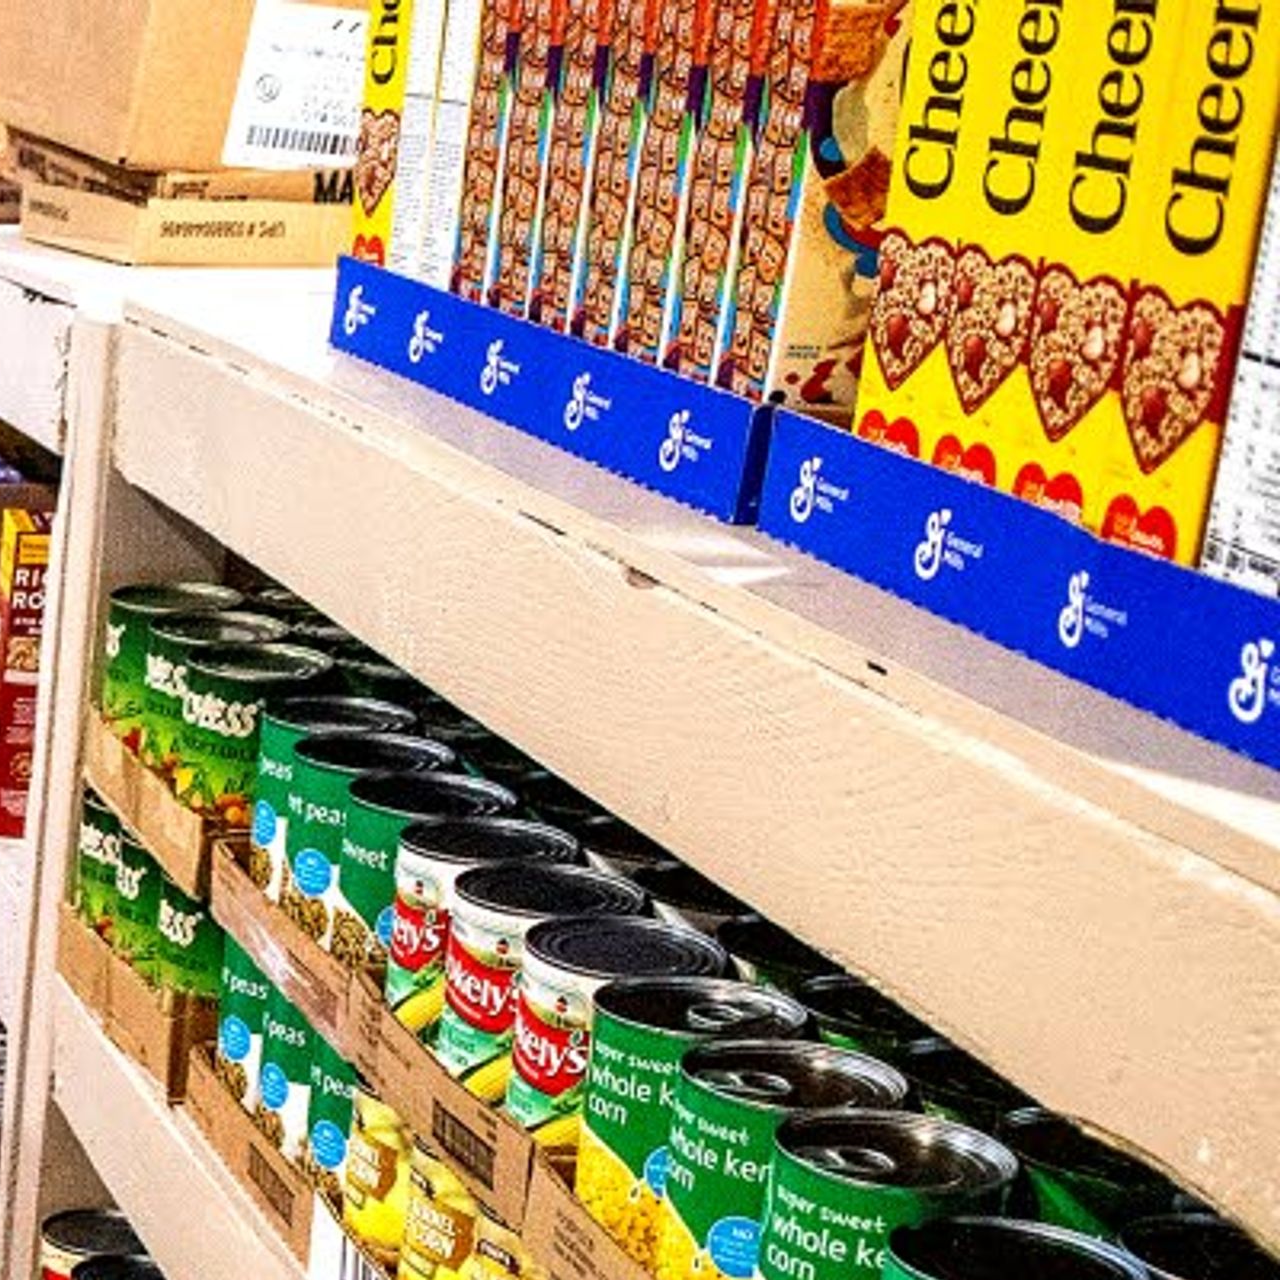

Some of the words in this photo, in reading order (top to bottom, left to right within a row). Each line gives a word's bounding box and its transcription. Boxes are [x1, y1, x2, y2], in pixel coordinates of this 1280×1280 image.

[234, 970, 269, 999] peas
[268, 1015, 307, 1046] peas
[630, 1048, 682, 1076] sweet
[591, 1063, 653, 1106] whole
[588, 1094, 629, 1127] corn
[697, 1115, 750, 1144] sweet
[819, 1203, 887, 1234] sweet
[771, 1212, 848, 1263] whole
